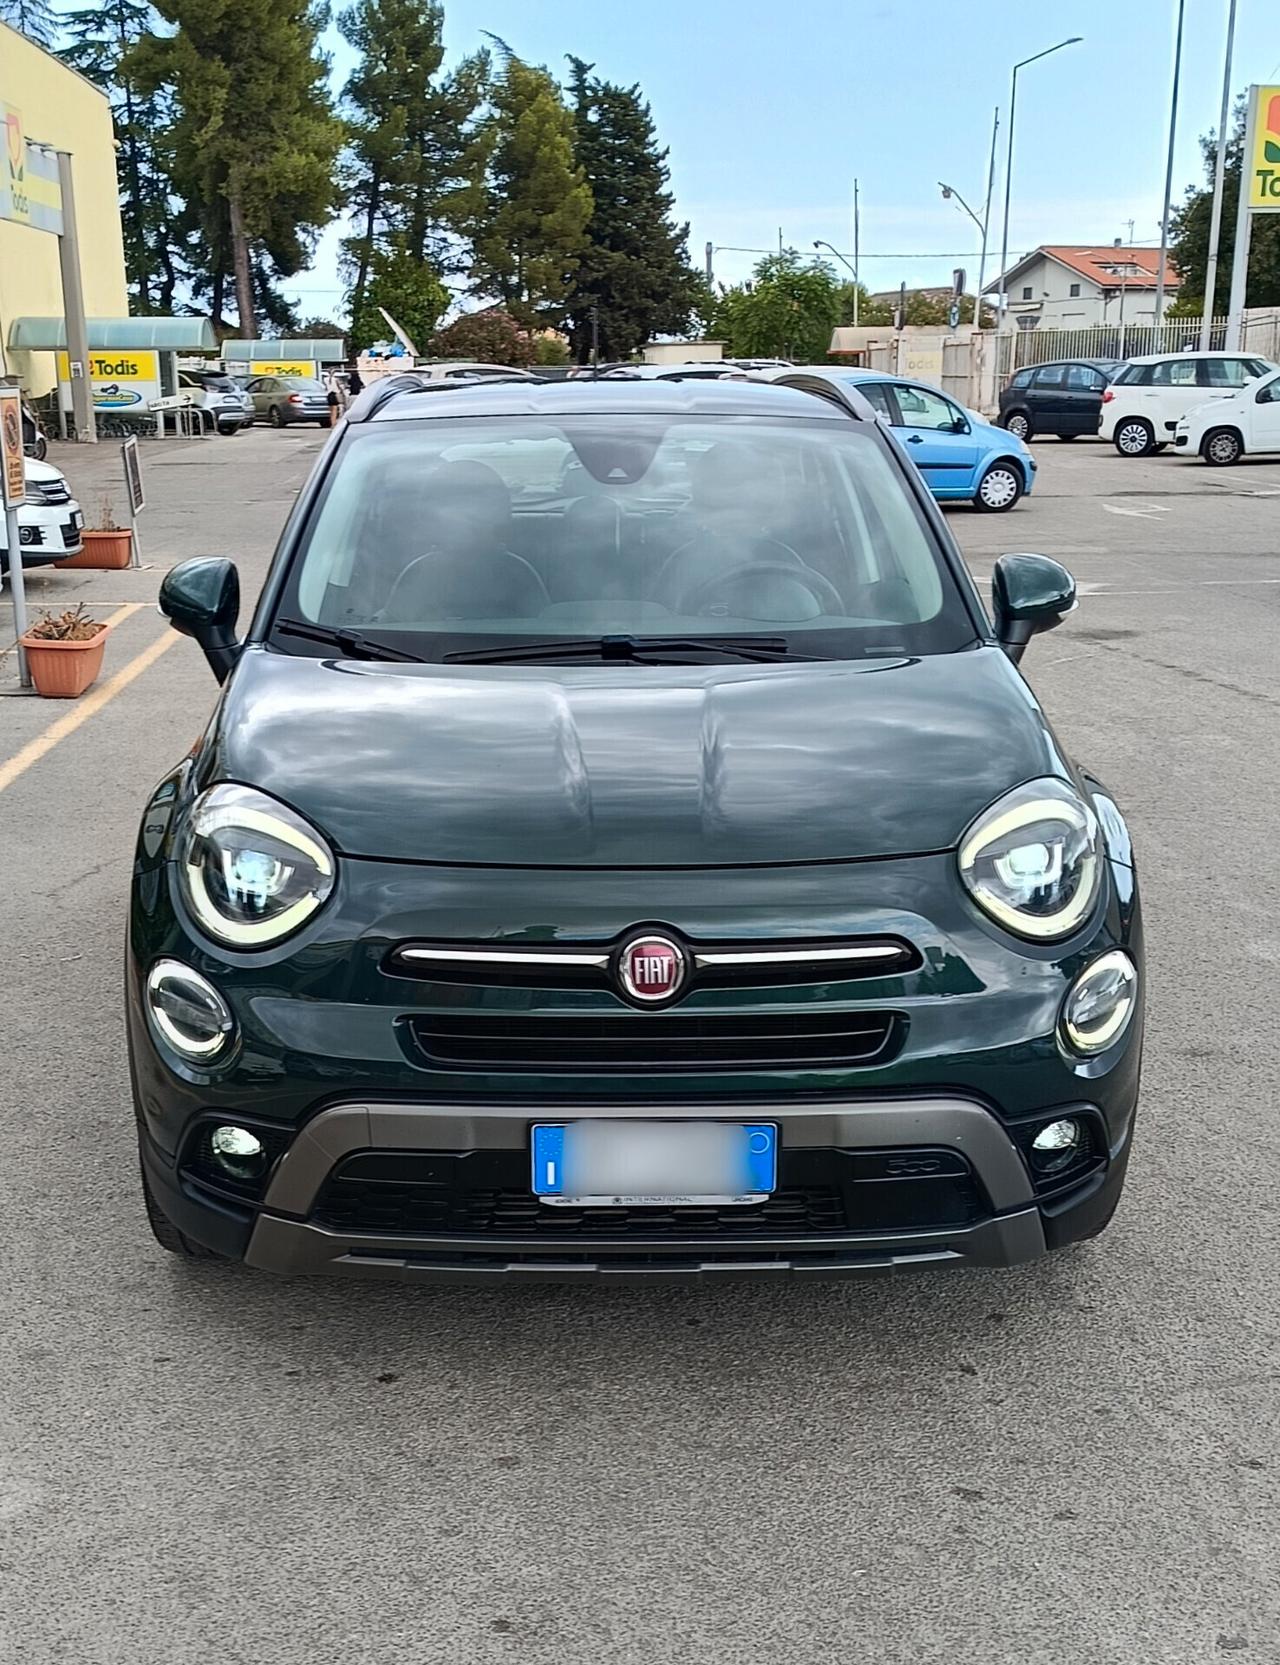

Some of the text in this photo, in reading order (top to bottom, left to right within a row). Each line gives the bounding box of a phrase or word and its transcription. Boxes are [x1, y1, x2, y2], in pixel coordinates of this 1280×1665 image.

[95, 360, 138, 375] Todis
[634, 956, 672, 984] FIAT
[886, 1159, 940, 1174] 500
